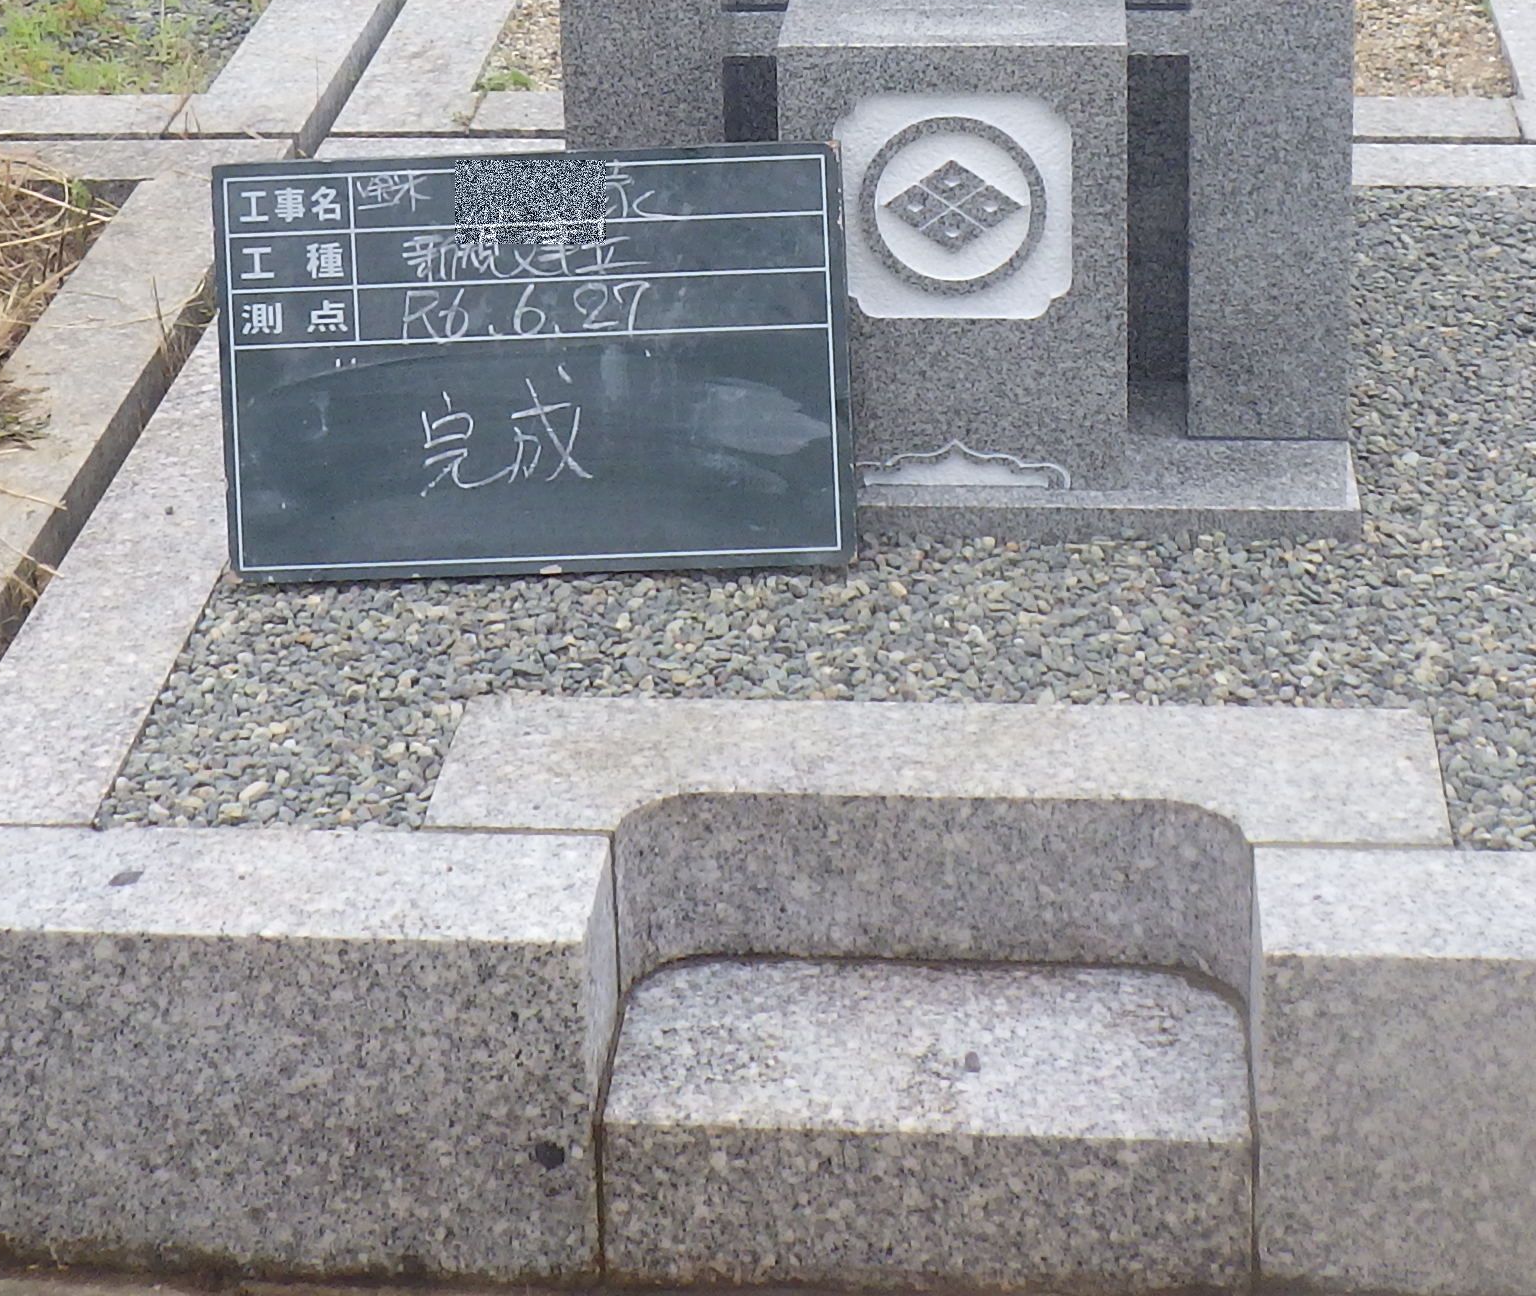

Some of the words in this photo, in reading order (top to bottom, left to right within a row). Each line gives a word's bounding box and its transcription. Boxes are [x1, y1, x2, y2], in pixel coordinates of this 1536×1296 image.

[239, 185, 342, 223] 工事名
[420, 364, 594, 498] 完成
